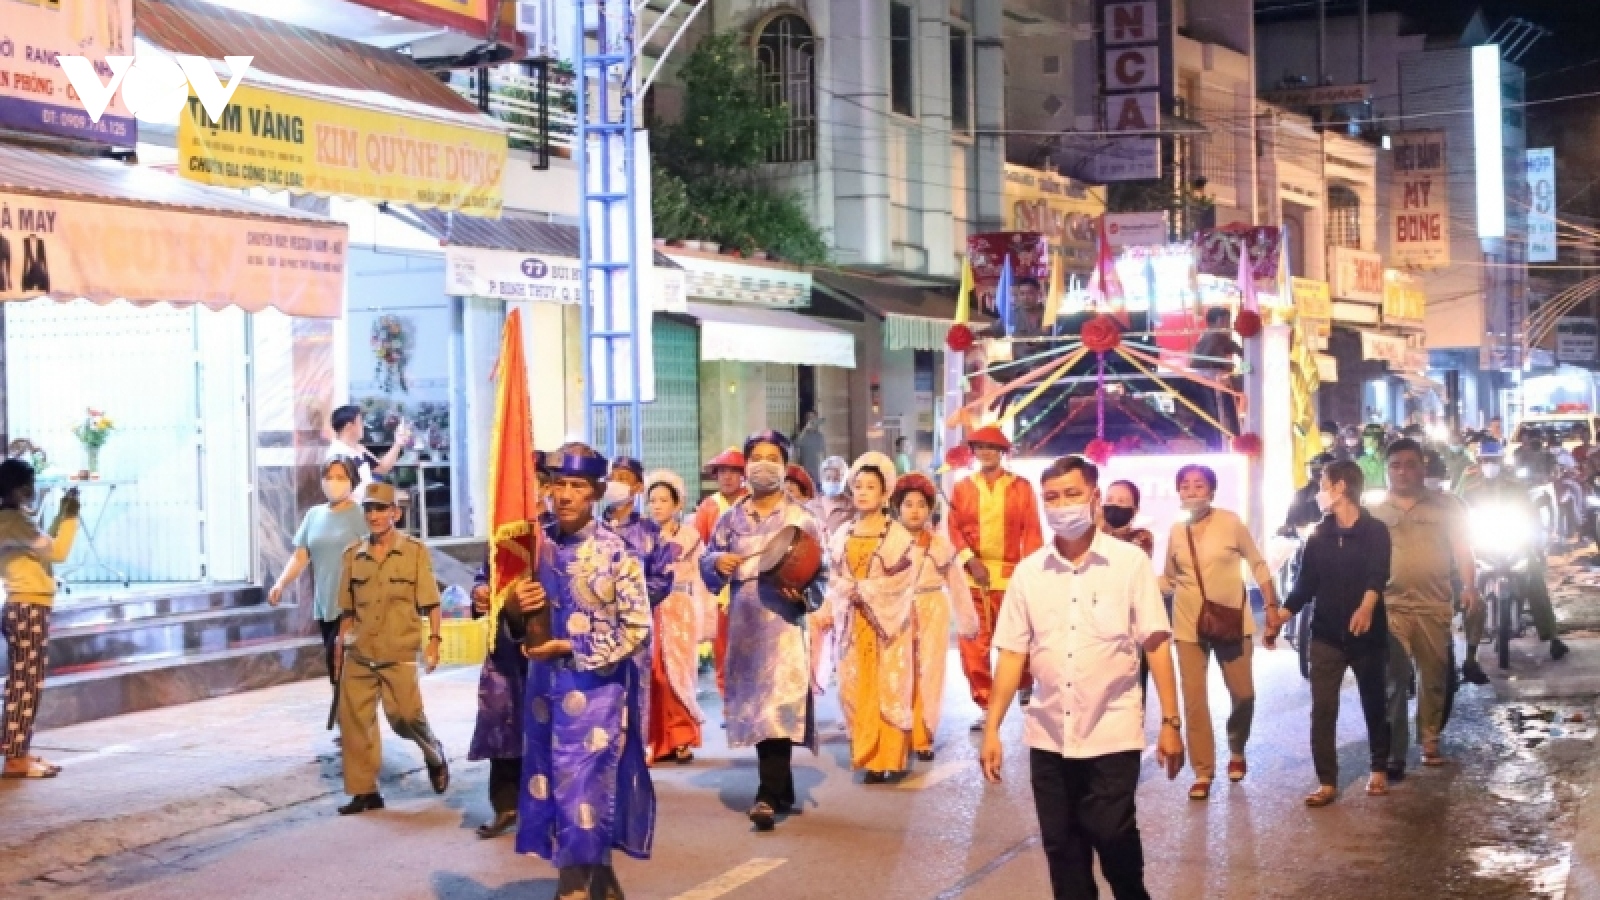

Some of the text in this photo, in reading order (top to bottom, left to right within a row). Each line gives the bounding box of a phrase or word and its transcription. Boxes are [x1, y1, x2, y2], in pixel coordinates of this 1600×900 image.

[248, 104, 305, 144] VÀNG
[314, 122, 359, 170] KIM
[19, 208, 57, 233] MAY
